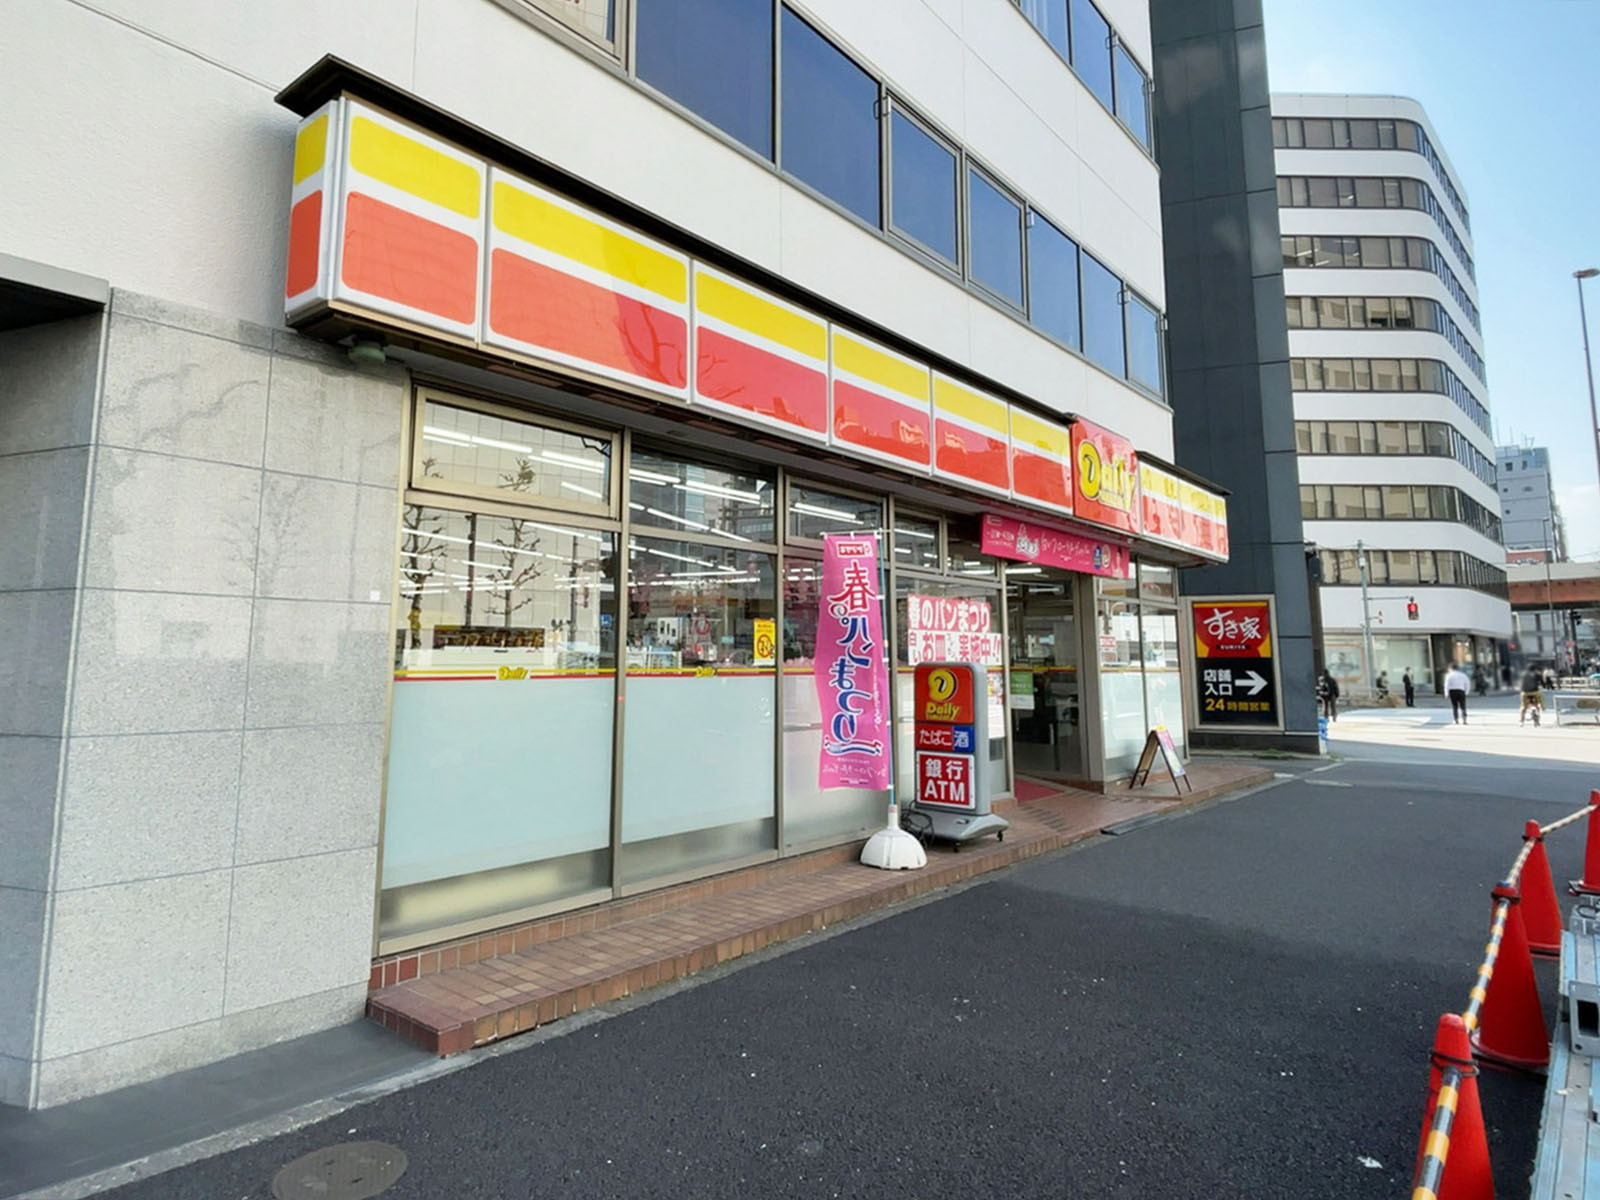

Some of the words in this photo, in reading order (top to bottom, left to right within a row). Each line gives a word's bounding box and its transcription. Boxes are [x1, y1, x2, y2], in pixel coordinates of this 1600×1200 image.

[1079, 439, 1136, 512] Daily
[909, 595, 990, 632] 春のパンまつり
[1203, 608, 1261, 643] すき家
[1205, 683, 1232, 695] 入口
[926, 702, 960, 720] Daily
[920, 729, 952, 746] たばこ
[954, 731, 969, 748] 酒
[925, 758, 963, 780] 銀行
[924, 779, 965, 802] ATM
